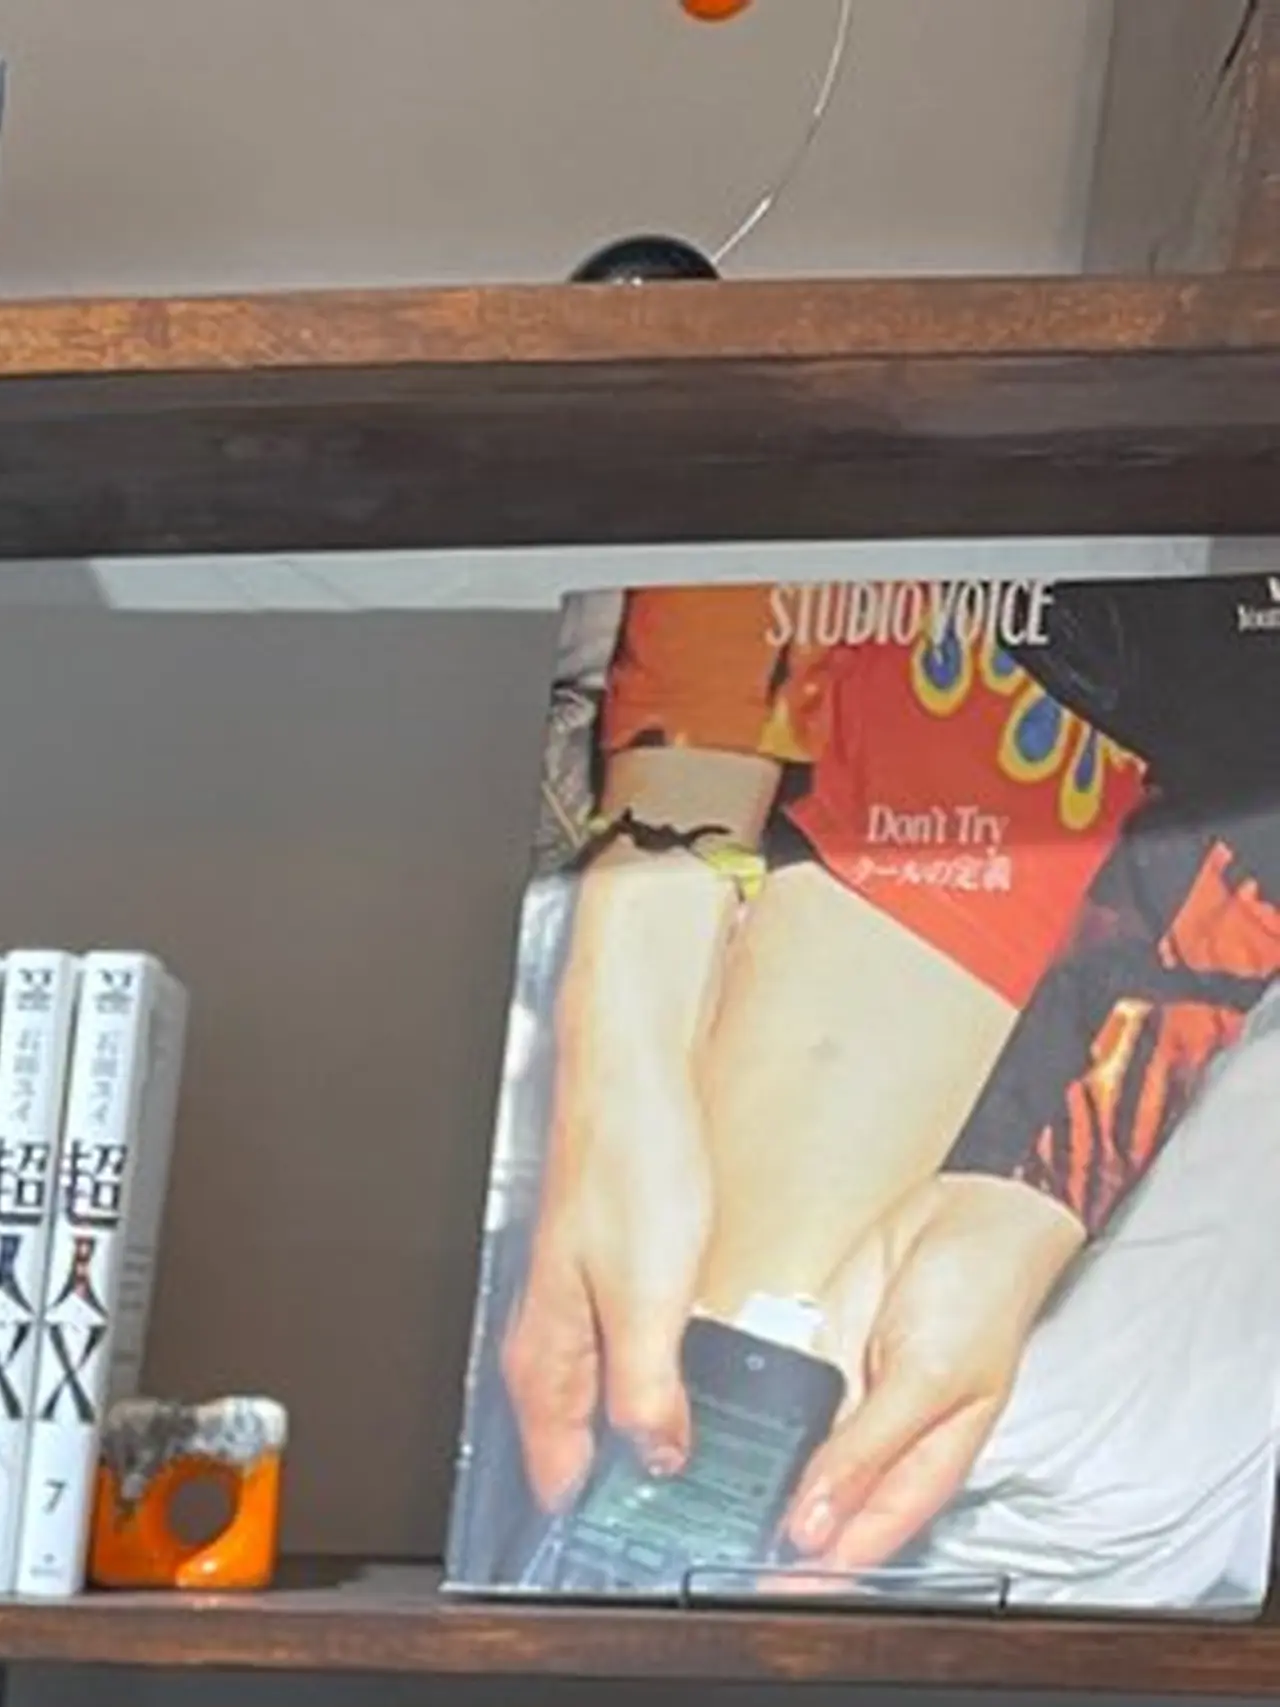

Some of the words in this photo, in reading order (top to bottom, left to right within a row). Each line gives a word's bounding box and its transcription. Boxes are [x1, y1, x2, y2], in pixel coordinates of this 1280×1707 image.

[765, 585, 922, 646] STUDIO
[930, 578, 1056, 650] VOICE
[954, 806, 1010, 849] Try
[42, 1479, 68, 1515] 7
